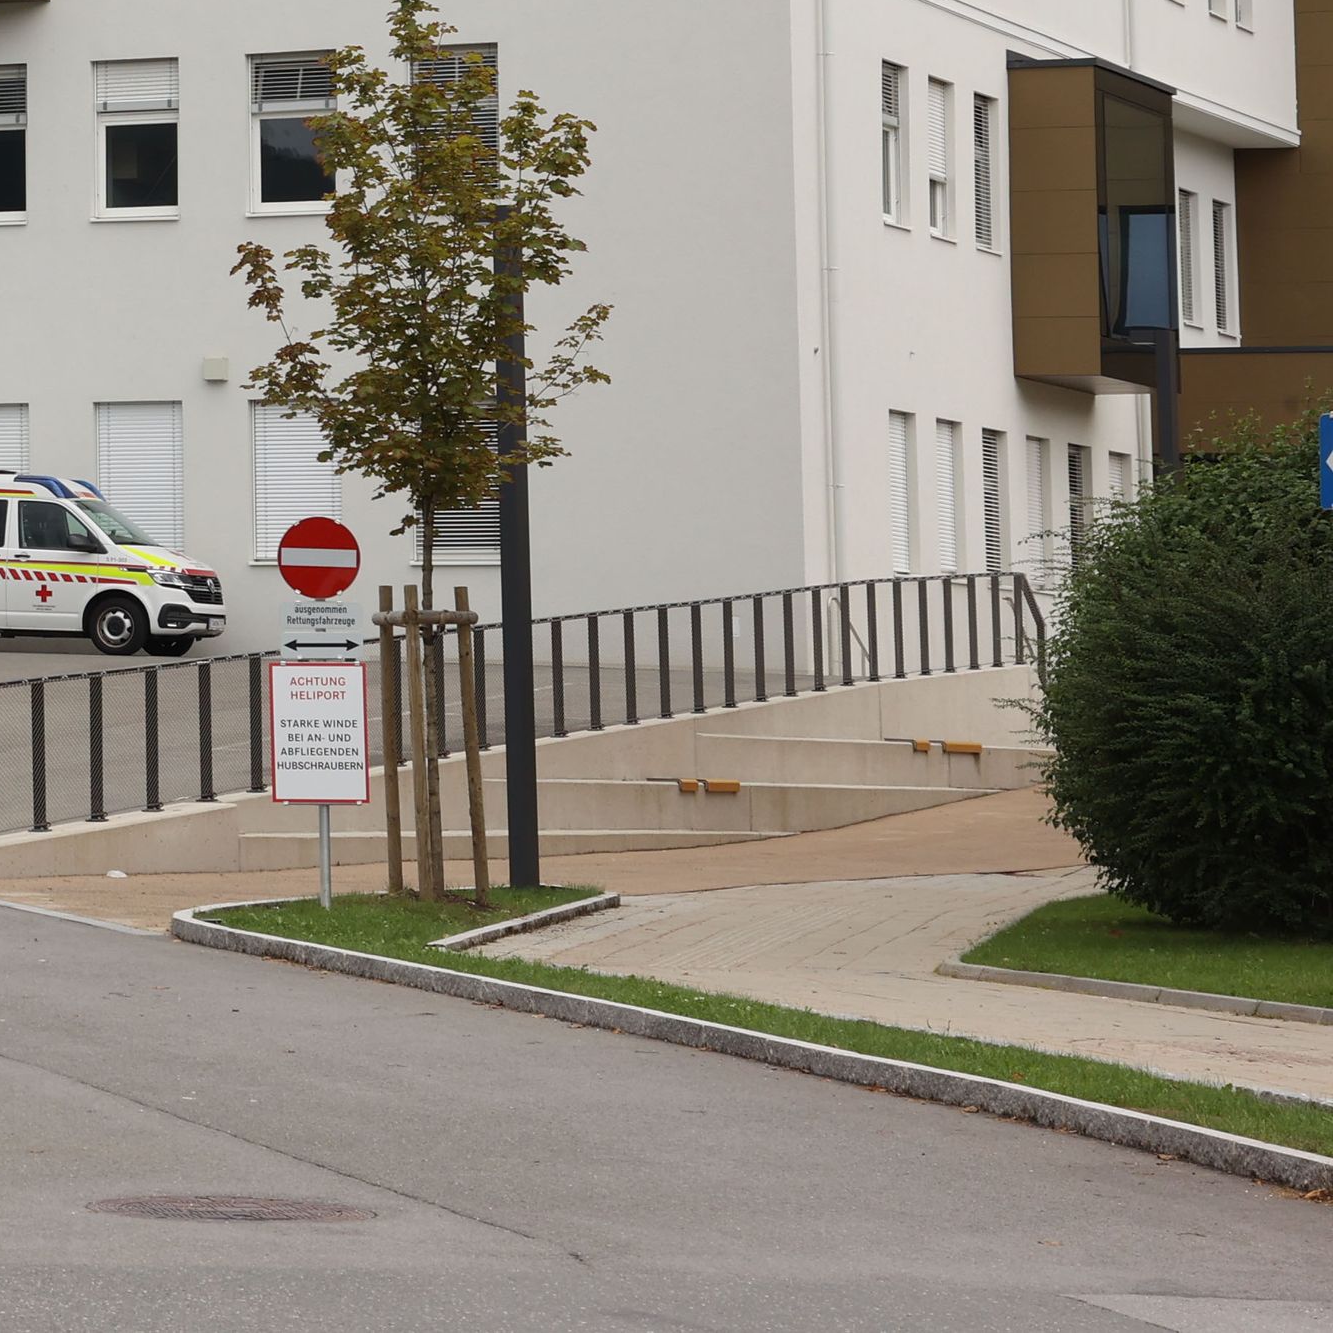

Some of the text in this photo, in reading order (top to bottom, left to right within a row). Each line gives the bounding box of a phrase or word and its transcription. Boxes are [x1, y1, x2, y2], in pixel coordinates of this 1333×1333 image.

[294, 606, 348, 616] ausgenommen
[286, 615, 356, 627] Rettungsfahrzeuge
[289, 676, 346, 687] ACHTUNG
[290, 690, 347, 700] HELIPORT
[280, 719, 358, 728] STARKE WINDE
[287, 733, 352, 742] BEI AN- UND
[280, 747, 359, 756] ABFLIEGENDEN
[276, 761, 364, 770] HUBSCHRAUBERN
